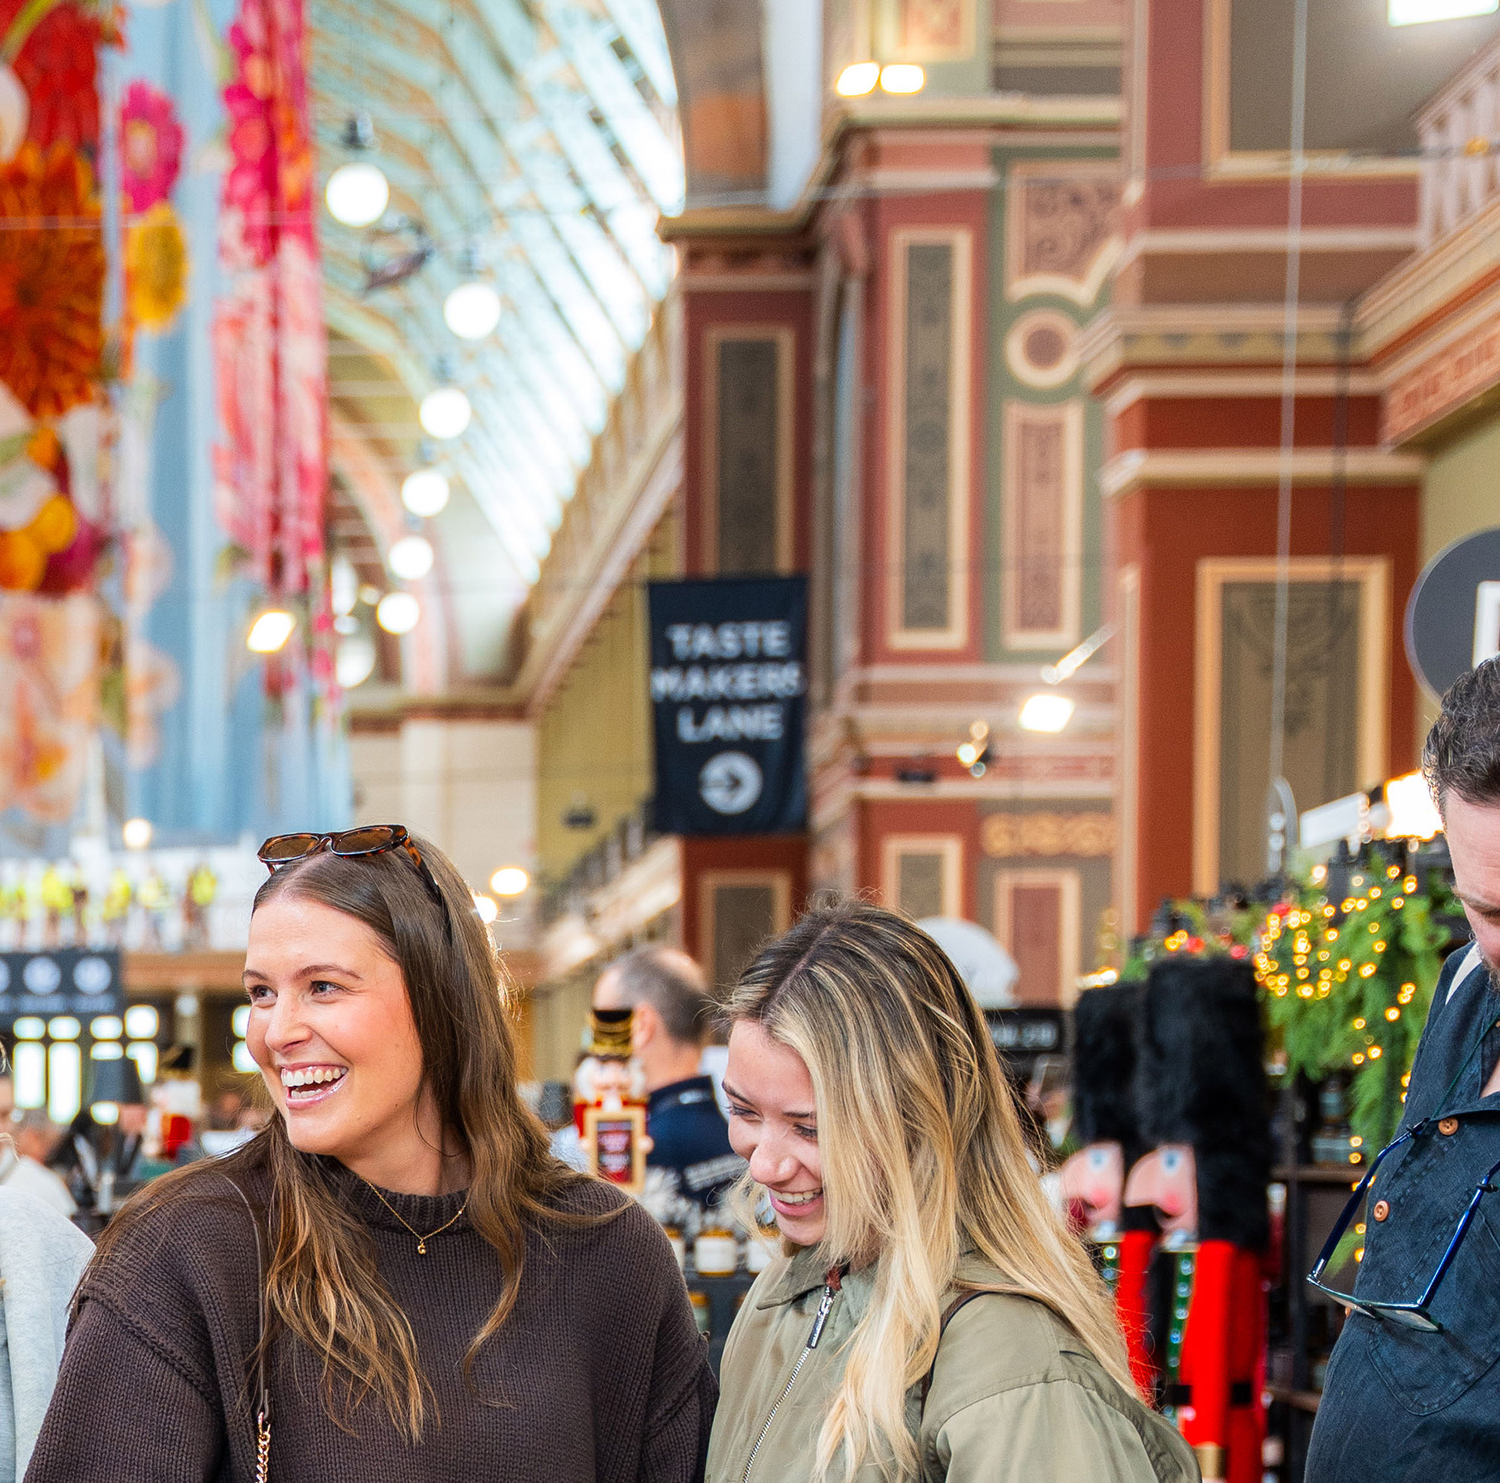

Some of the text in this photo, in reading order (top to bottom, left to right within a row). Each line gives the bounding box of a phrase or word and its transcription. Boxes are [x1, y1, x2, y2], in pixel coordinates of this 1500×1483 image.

[666, 621, 792, 660] TASTE
[651, 662, 806, 701] MAKERS
[677, 704, 784, 743] LANE
